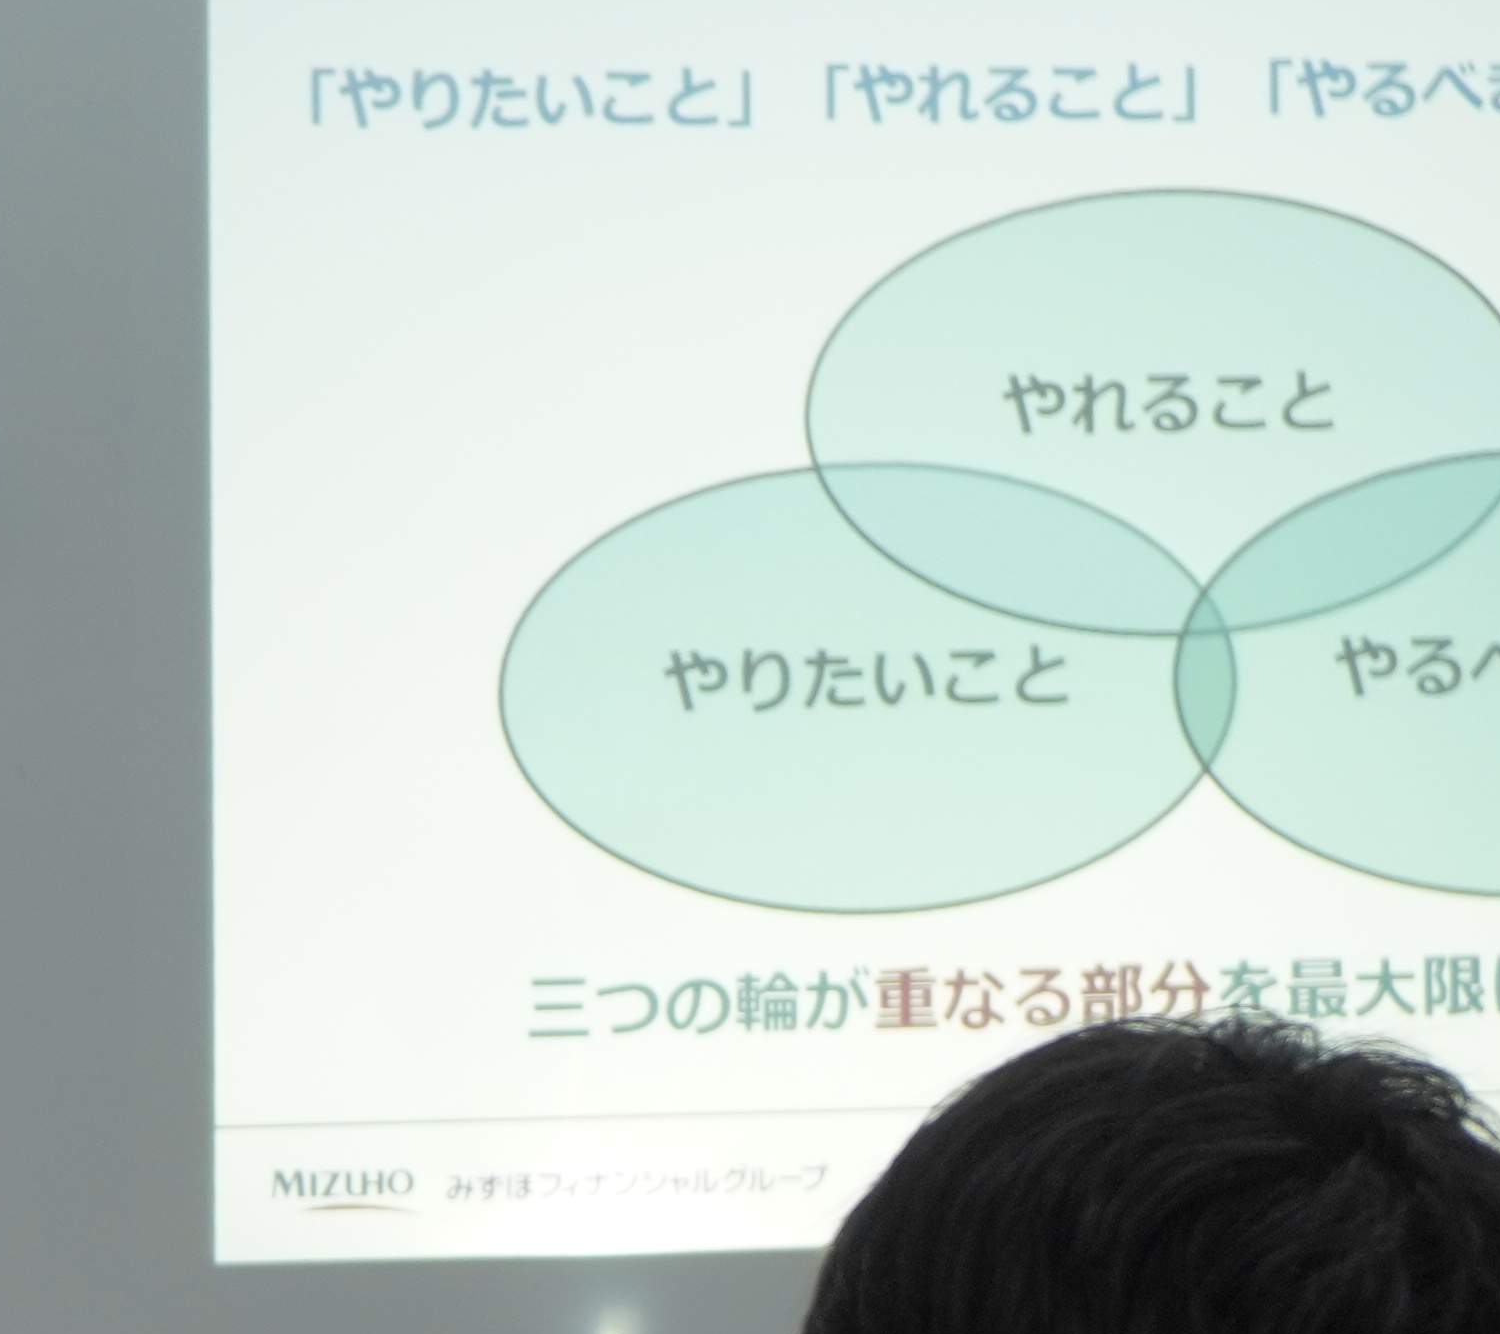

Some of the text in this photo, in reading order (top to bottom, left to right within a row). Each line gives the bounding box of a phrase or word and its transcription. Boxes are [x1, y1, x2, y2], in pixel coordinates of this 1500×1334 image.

[1003, 370, 1335, 435] やれること
[663, 643, 1070, 713] やりたいこと
[272, 1169, 415, 1198] MIZUHO
[445, 1163, 829, 1202] みずほフィナンシャルグループ
